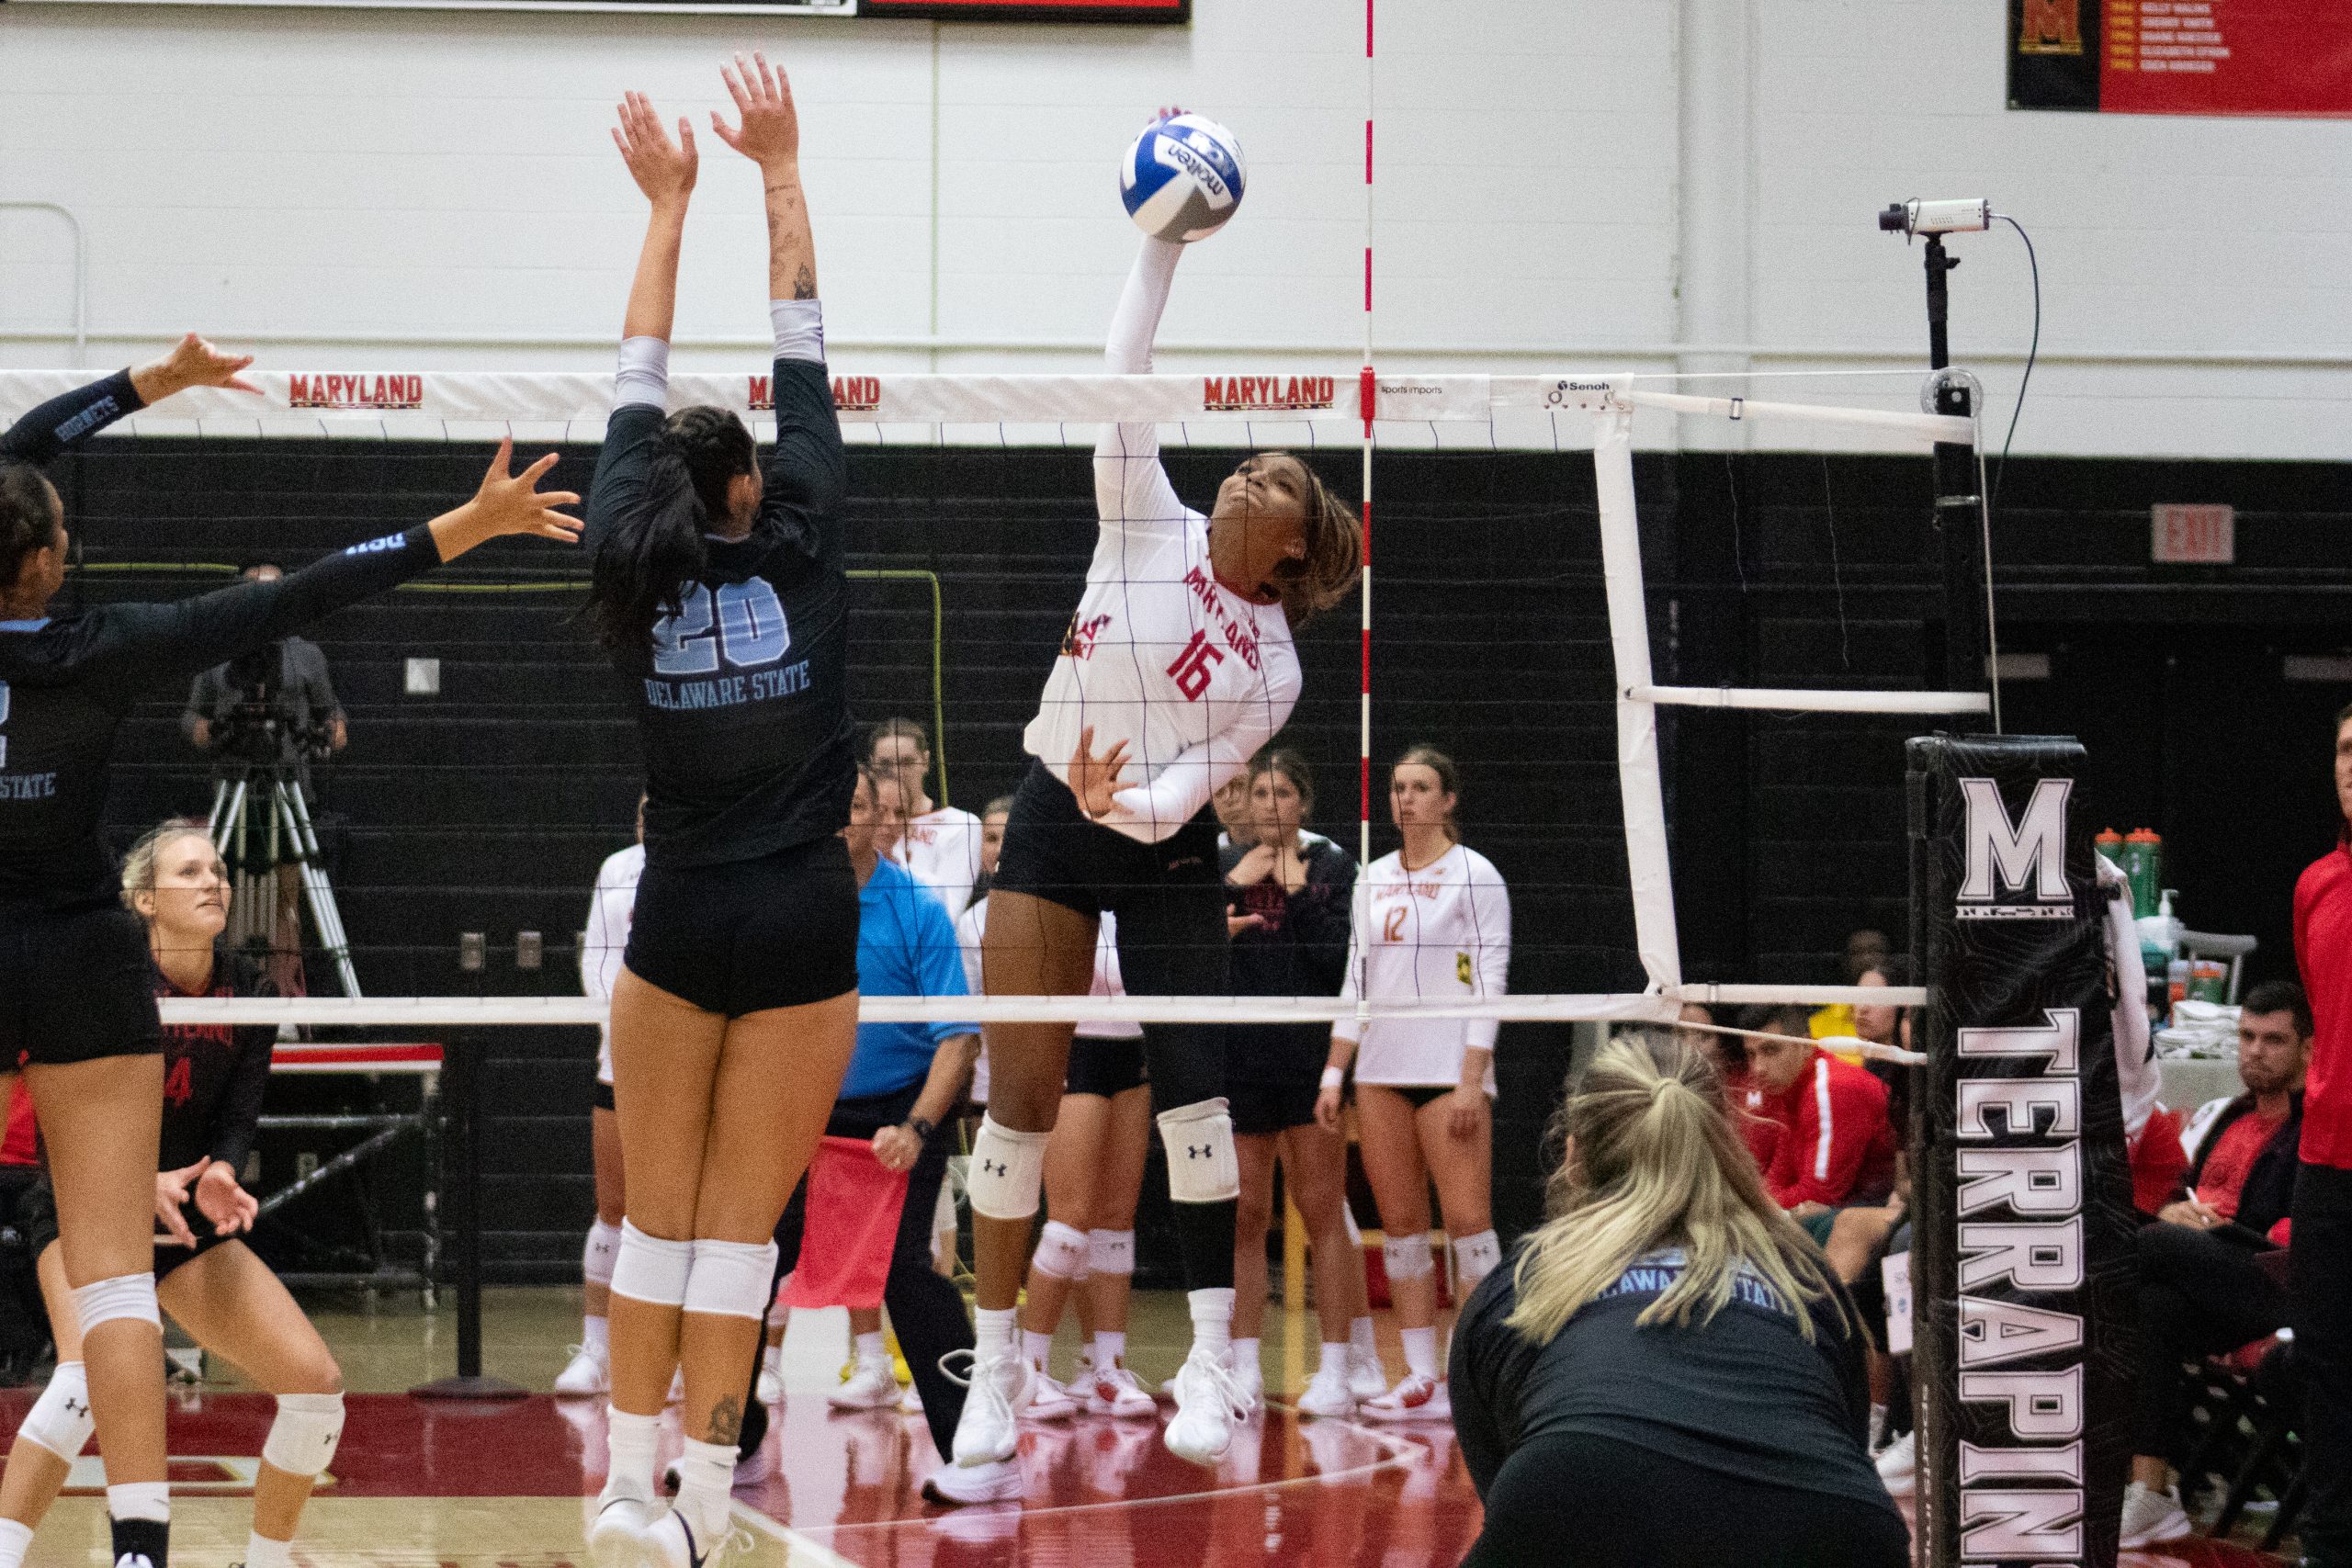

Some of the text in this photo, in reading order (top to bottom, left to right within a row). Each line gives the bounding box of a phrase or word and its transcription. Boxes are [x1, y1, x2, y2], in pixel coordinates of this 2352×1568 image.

[1168, 144, 1224, 196] molten
[288, 373, 423, 402] MARYLAND
[748, 376, 881, 404] MAND
[1204, 376, 1334, 404] MARYLAND
[1381, 385, 1442, 395] sports imports
[1569, 381, 1610, 390] Senoh
[651, 576, 791, 674] 20
[1166, 628, 1225, 702] 16
[645, 660, 810, 710] DELAWARE STATE
[0, 773, 56, 799] STATE
[1956, 778, 2075, 900] M
[1384, 907, 1408, 942] 12
[1956, 1008, 2085, 1568] TERRAPIN
